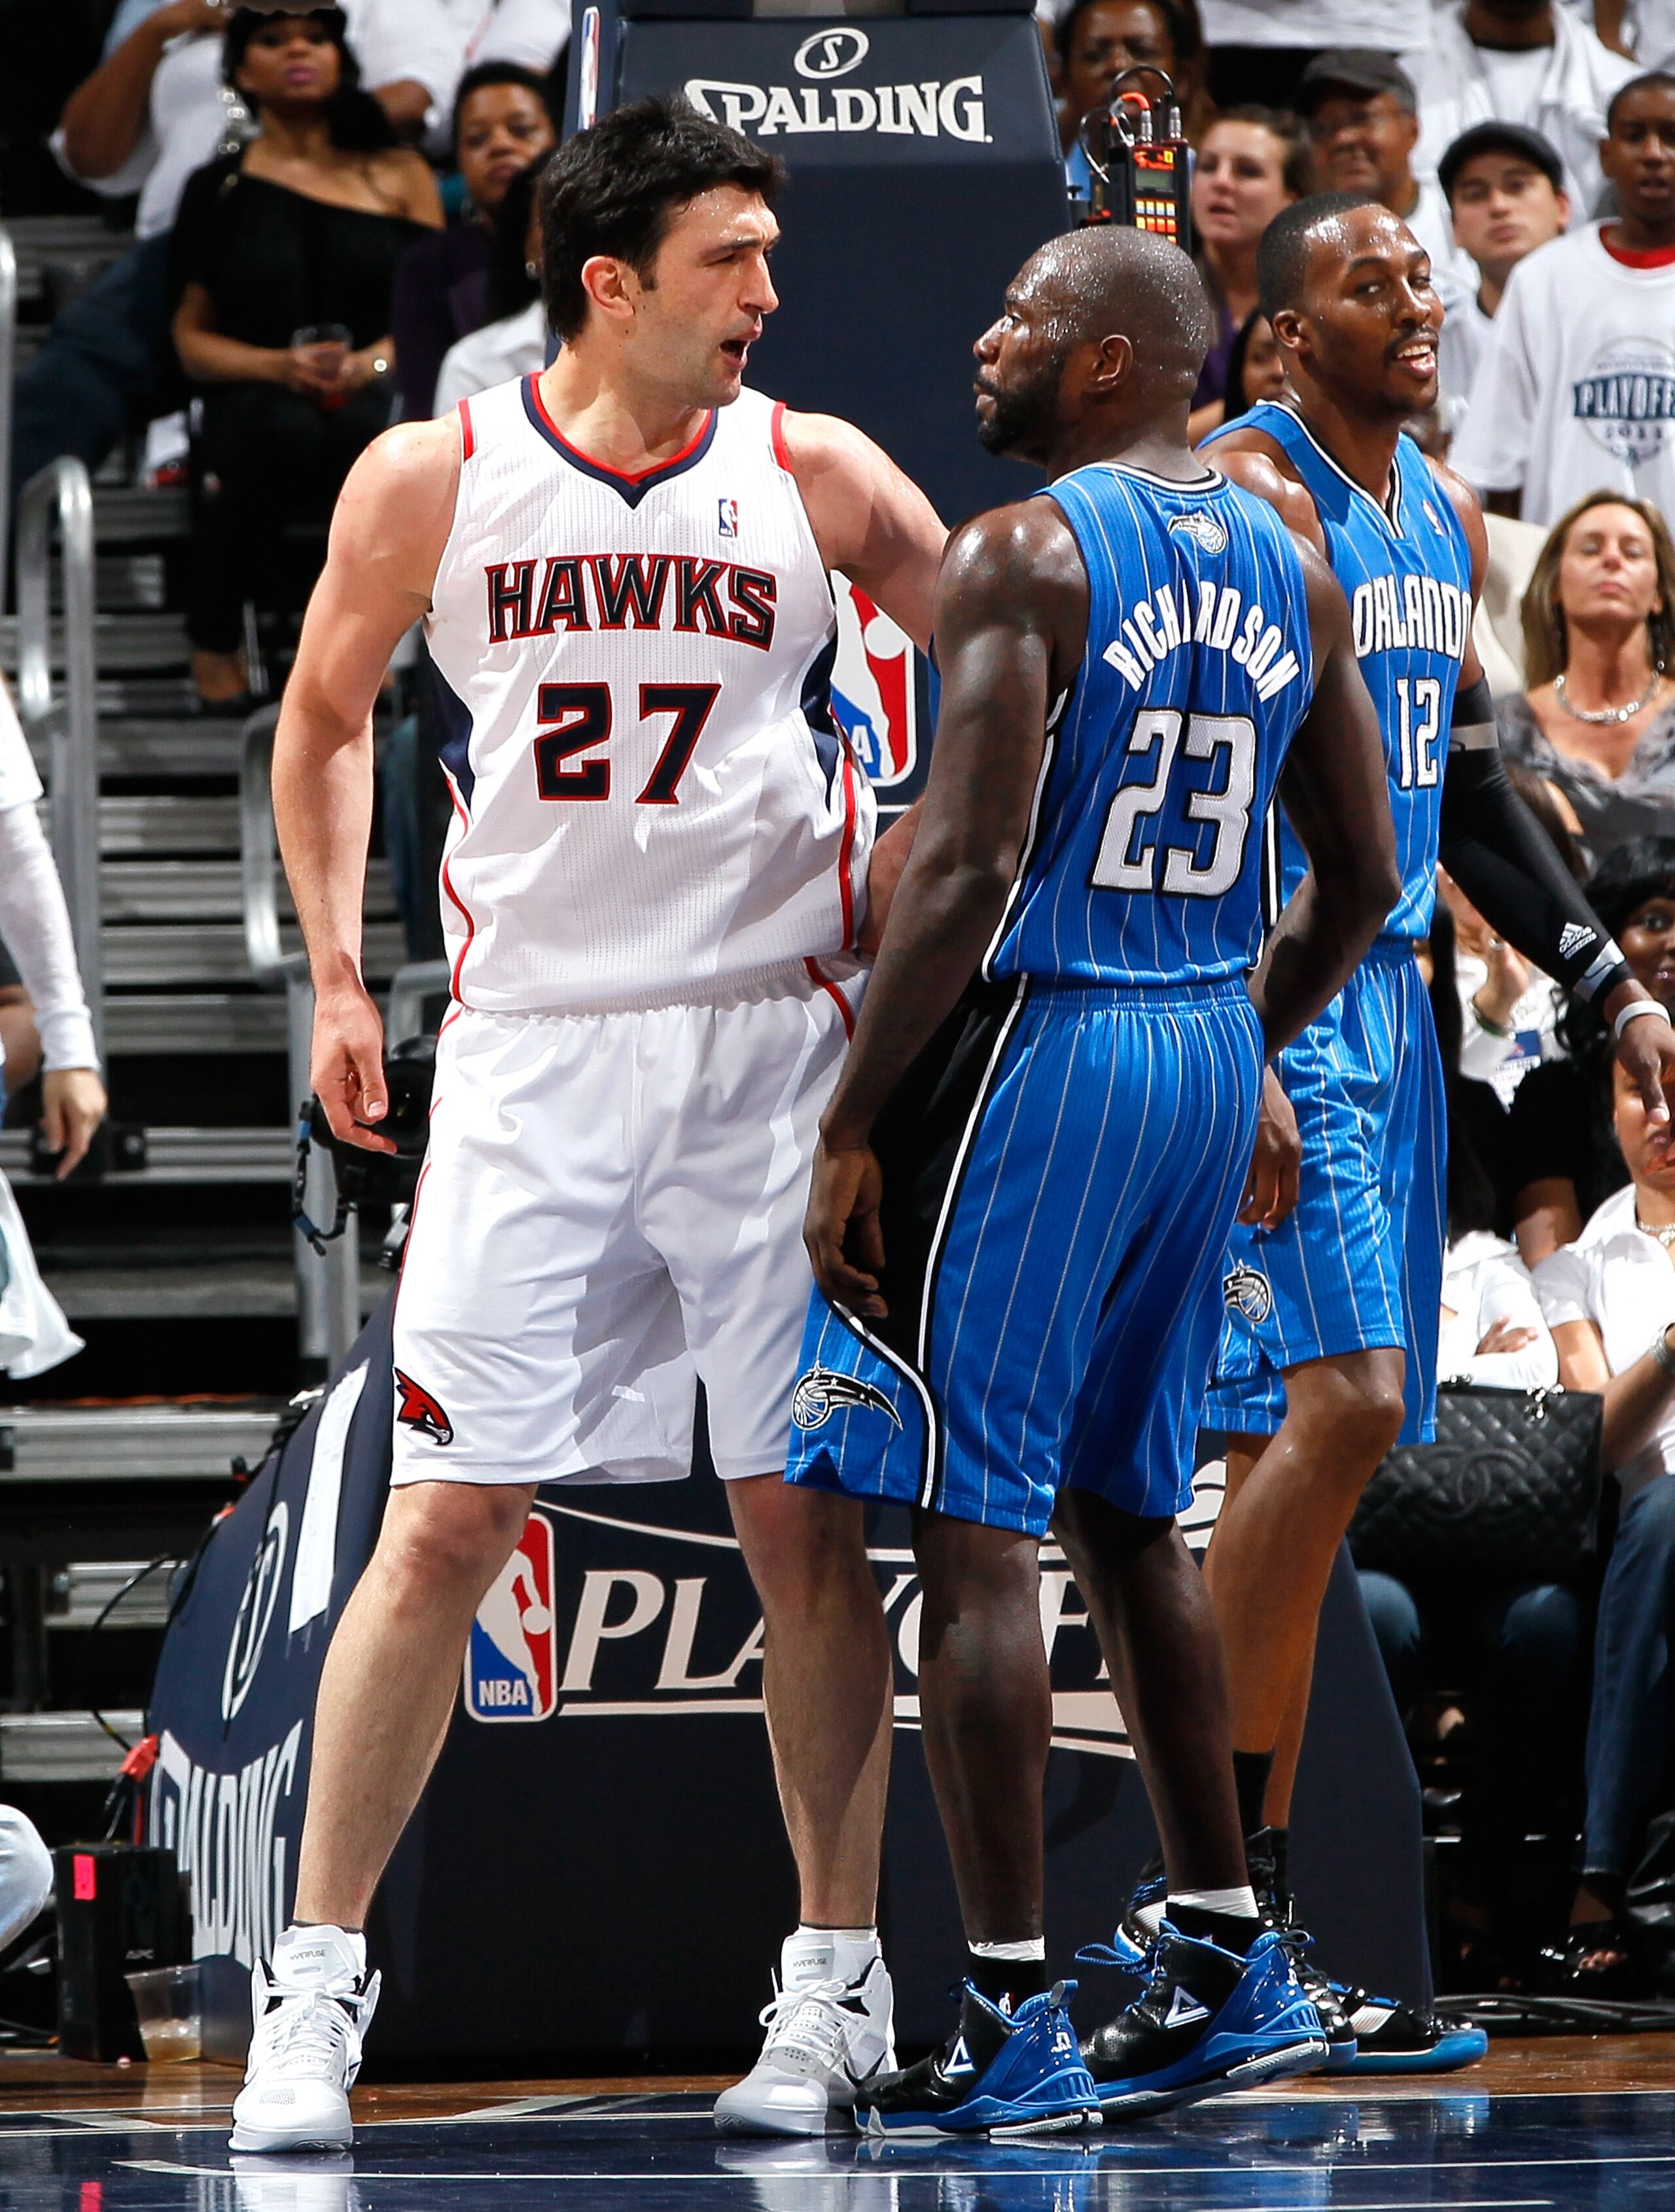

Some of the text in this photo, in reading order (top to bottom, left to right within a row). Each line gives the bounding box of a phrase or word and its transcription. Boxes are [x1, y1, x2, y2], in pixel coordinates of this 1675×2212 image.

[684, 75, 993, 143] SPALDING
[1578, 374, 1675, 419] PLAYOFF
[484, 553, 777, 652] HAWKS
[1352, 574, 1472, 666] ORLANDO
[534, 682, 722, 804] 27
[1395, 677, 1441, 789] 12
[1091, 709, 1256, 896] 23
[478, 1679, 528, 1707] NBA
